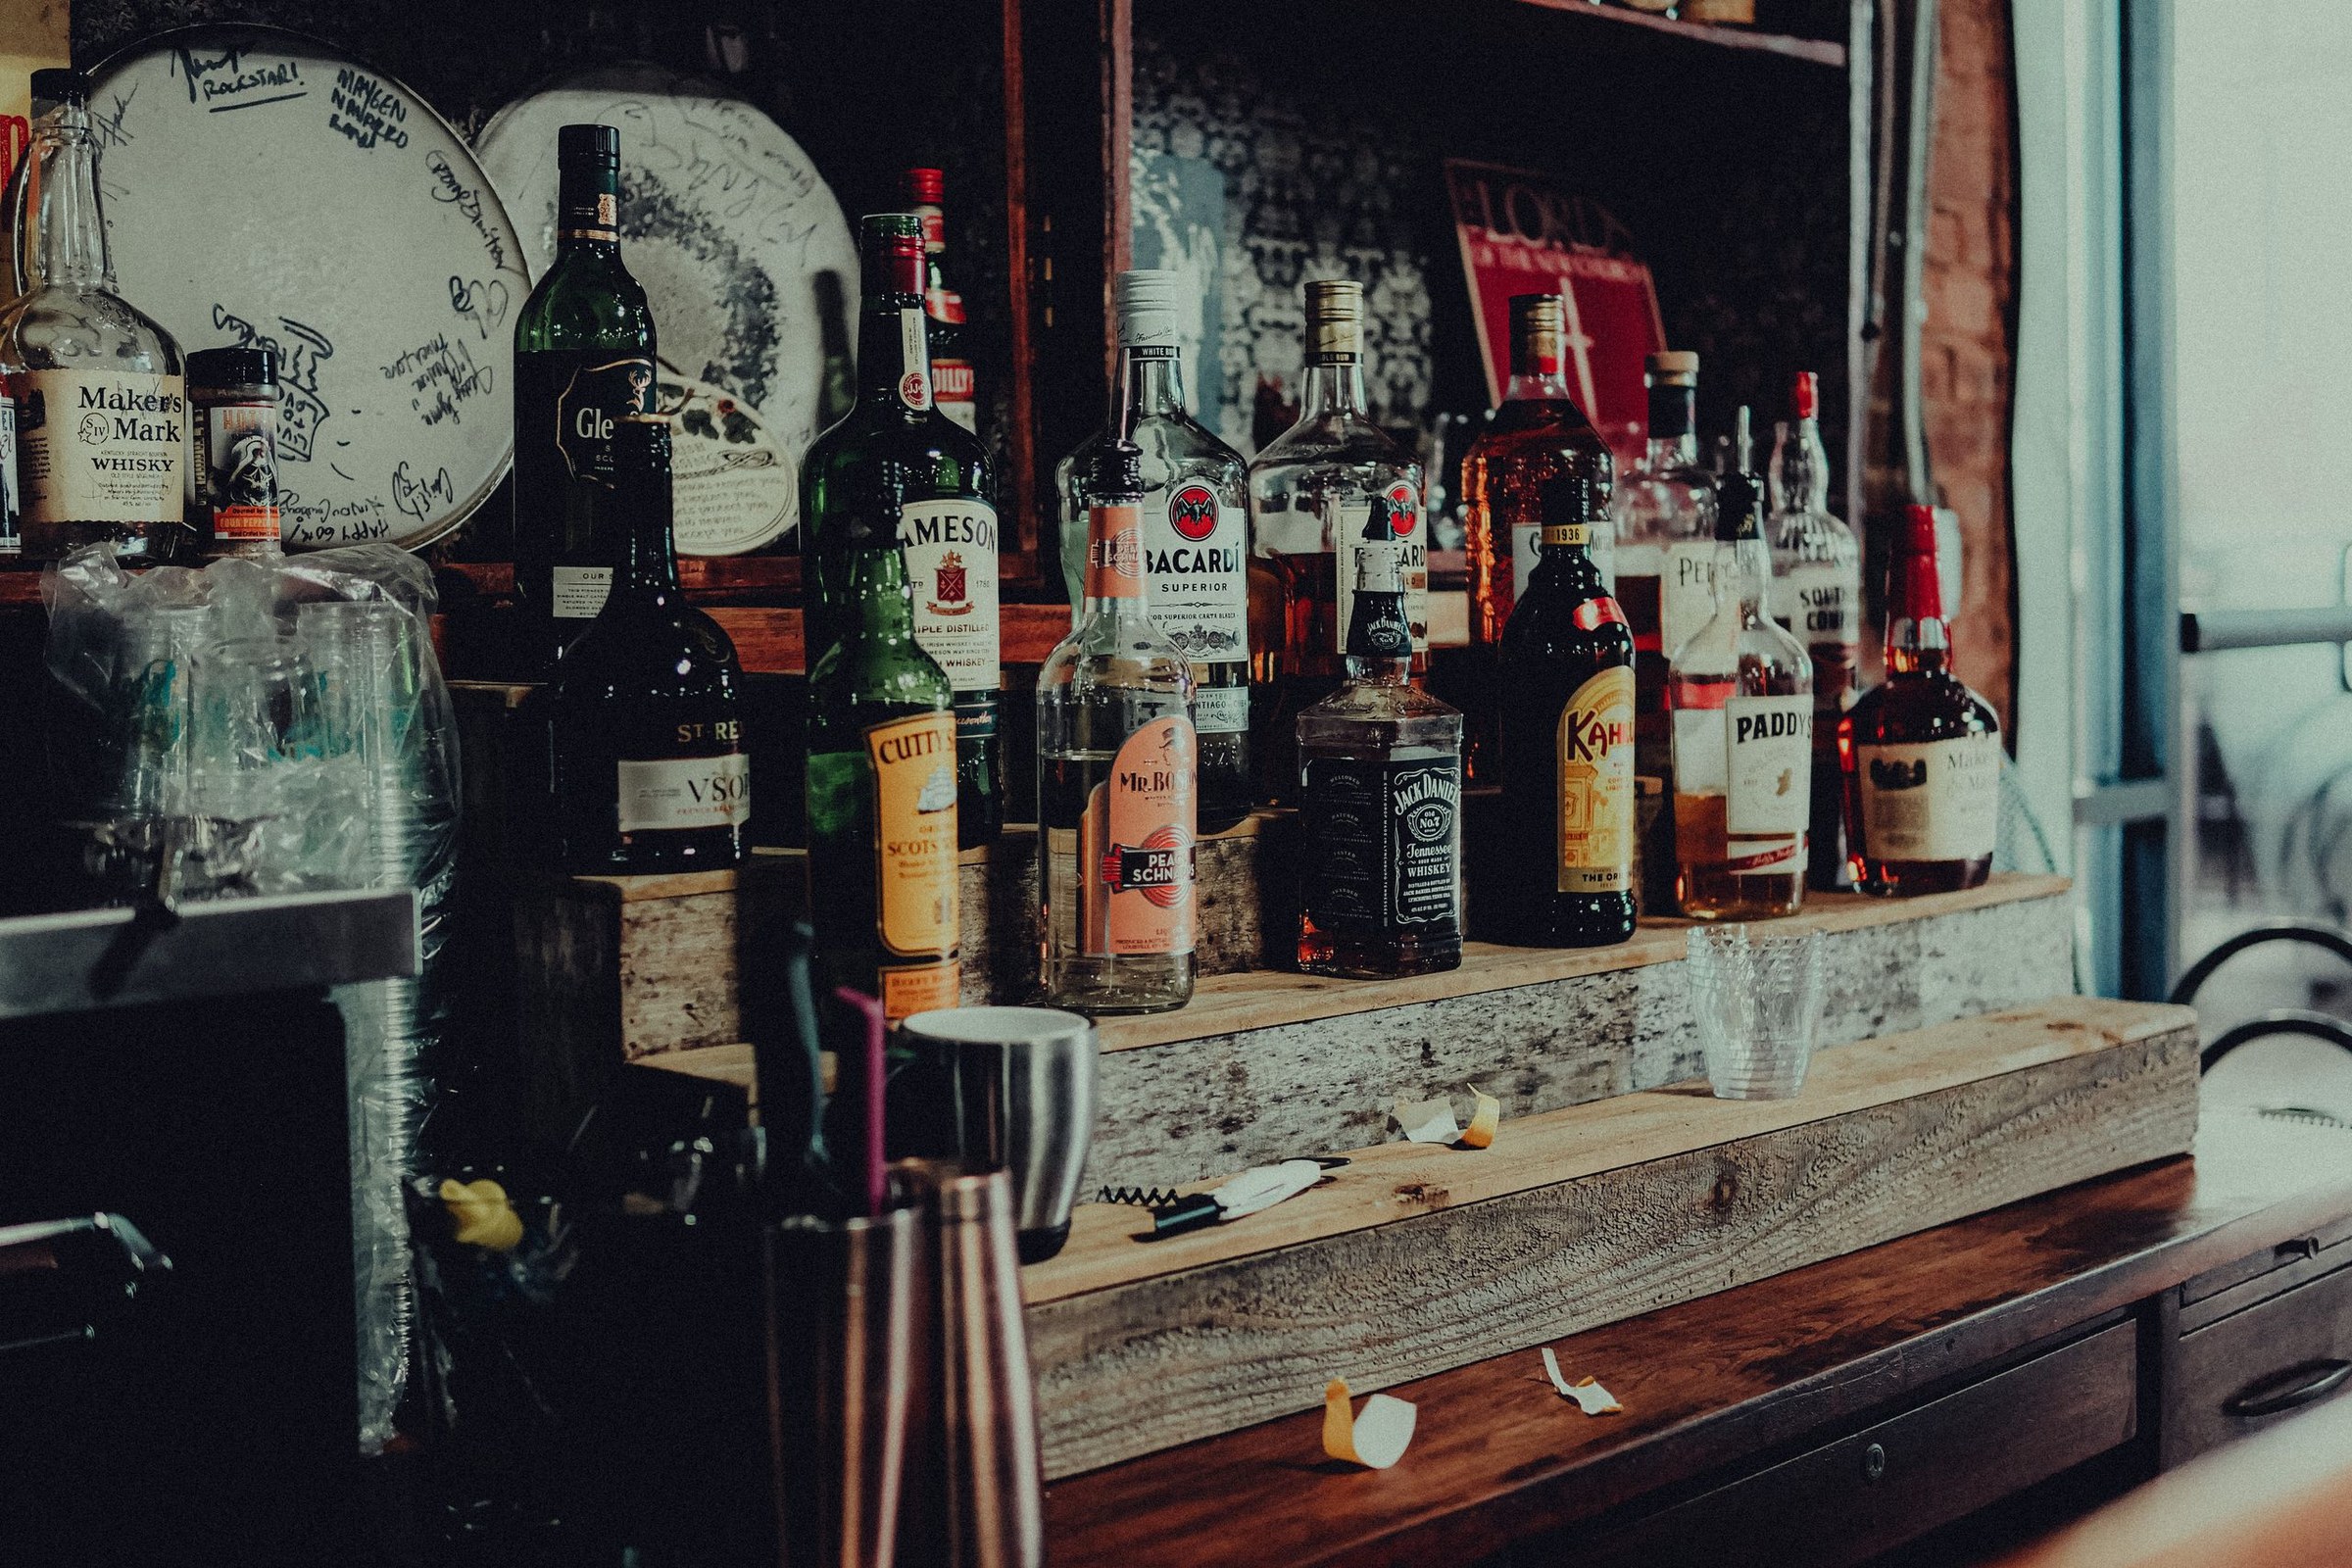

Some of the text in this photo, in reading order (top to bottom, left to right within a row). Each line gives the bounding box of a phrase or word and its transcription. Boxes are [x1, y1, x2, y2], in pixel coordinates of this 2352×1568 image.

[1142, 347, 1164, 356] WHITE
[77, 385, 182, 414] Maker's
[113, 417, 181, 442] Mark
[91, 458, 174, 472] WHISKY
[342, 518, 389, 540] HAPPY
[1555, 528, 1580, 541] 1936
[1146, 541, 1240, 574] BACARDÍ
[1161, 583, 1228, 593] SUPERIOR
[1164, 613, 1197, 622] SUPERIOR
[947, 624, 989, 633] DISTILLED
[946, 658, 986, 667] WHISKEY
[1567, 710, 1634, 761] KAH
[1393, 781, 1423, 816] JACK
[1406, 843, 1451, 858] Tennessee
[1149, 854, 1184, 867] PEA
[1133, 863, 1195, 882] SCHNS
[1407, 862, 1451, 878] WHISKEY
[1582, 873, 1603, 882] THE
